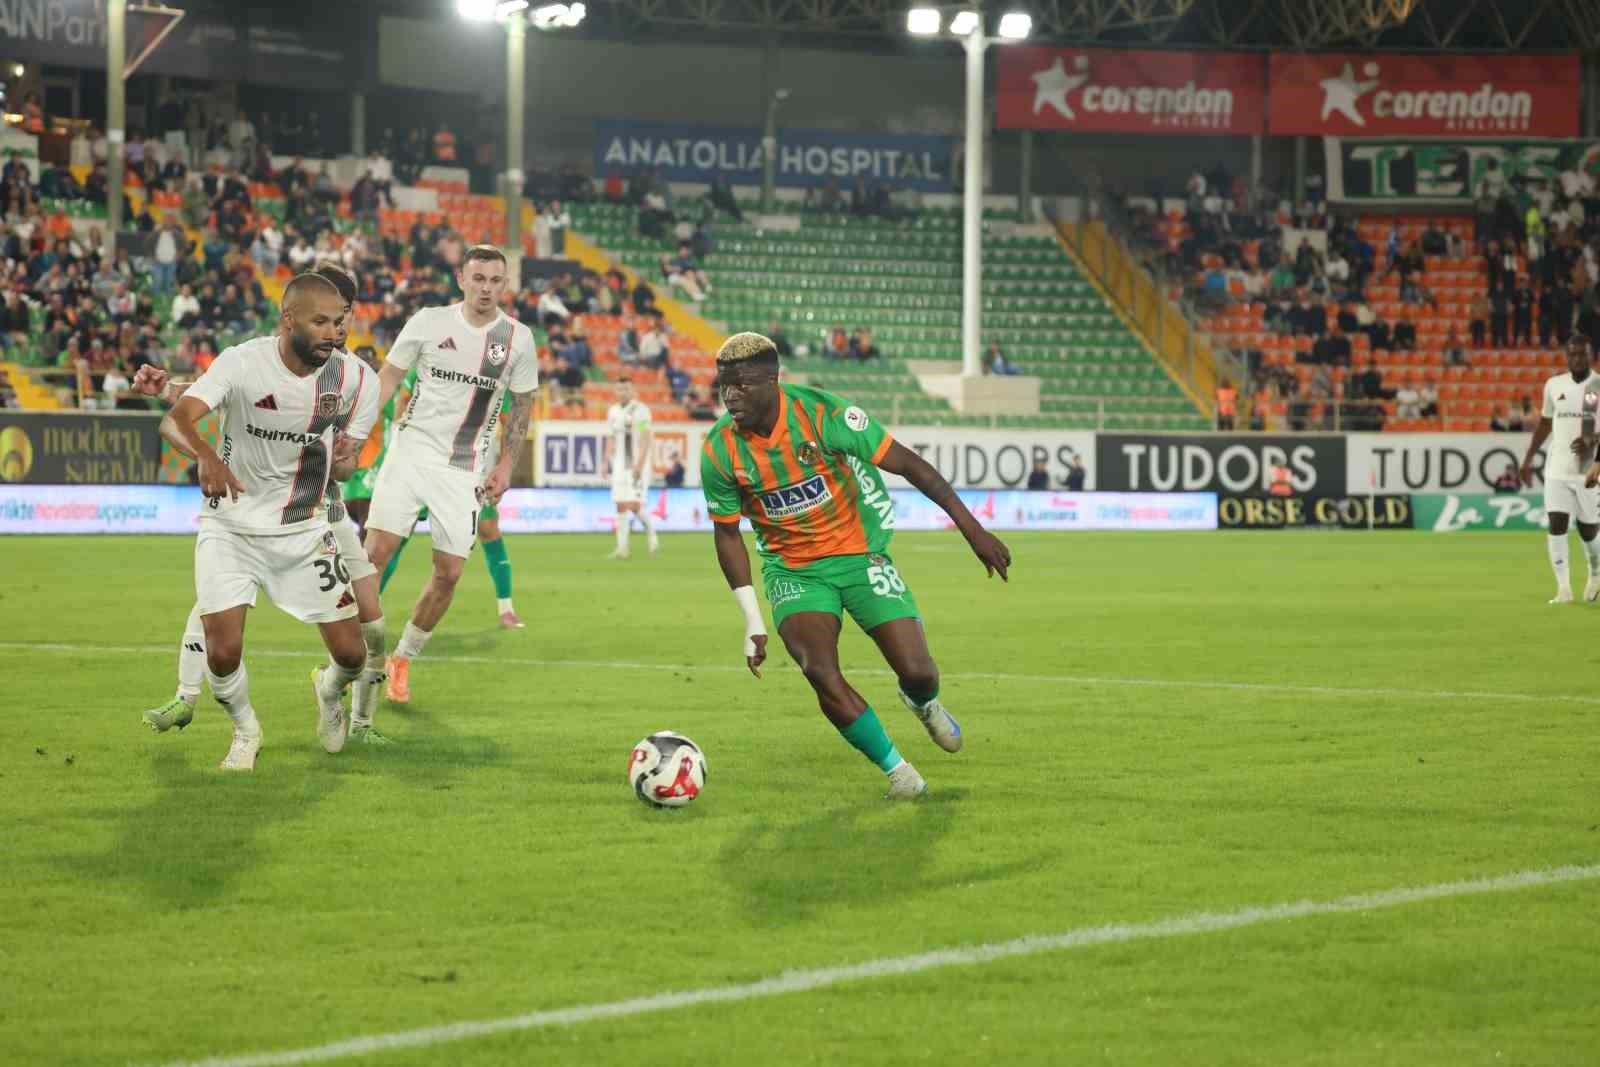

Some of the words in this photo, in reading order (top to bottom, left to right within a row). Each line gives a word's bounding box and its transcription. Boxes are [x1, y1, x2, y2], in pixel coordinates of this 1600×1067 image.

[1081, 80, 1233, 114] corendon
[1373, 83, 1533, 118] corendon
[604, 136, 766, 170] ANATOLIA
[781, 146, 942, 181] HOSPITAL
[43, 419, 142, 456] modern
[1121, 443, 1318, 492] TUDORS
[1219, 497, 1306, 525] ORSE
[1314, 496, 1409, 525] GOLD
[866, 564, 906, 596] 58
